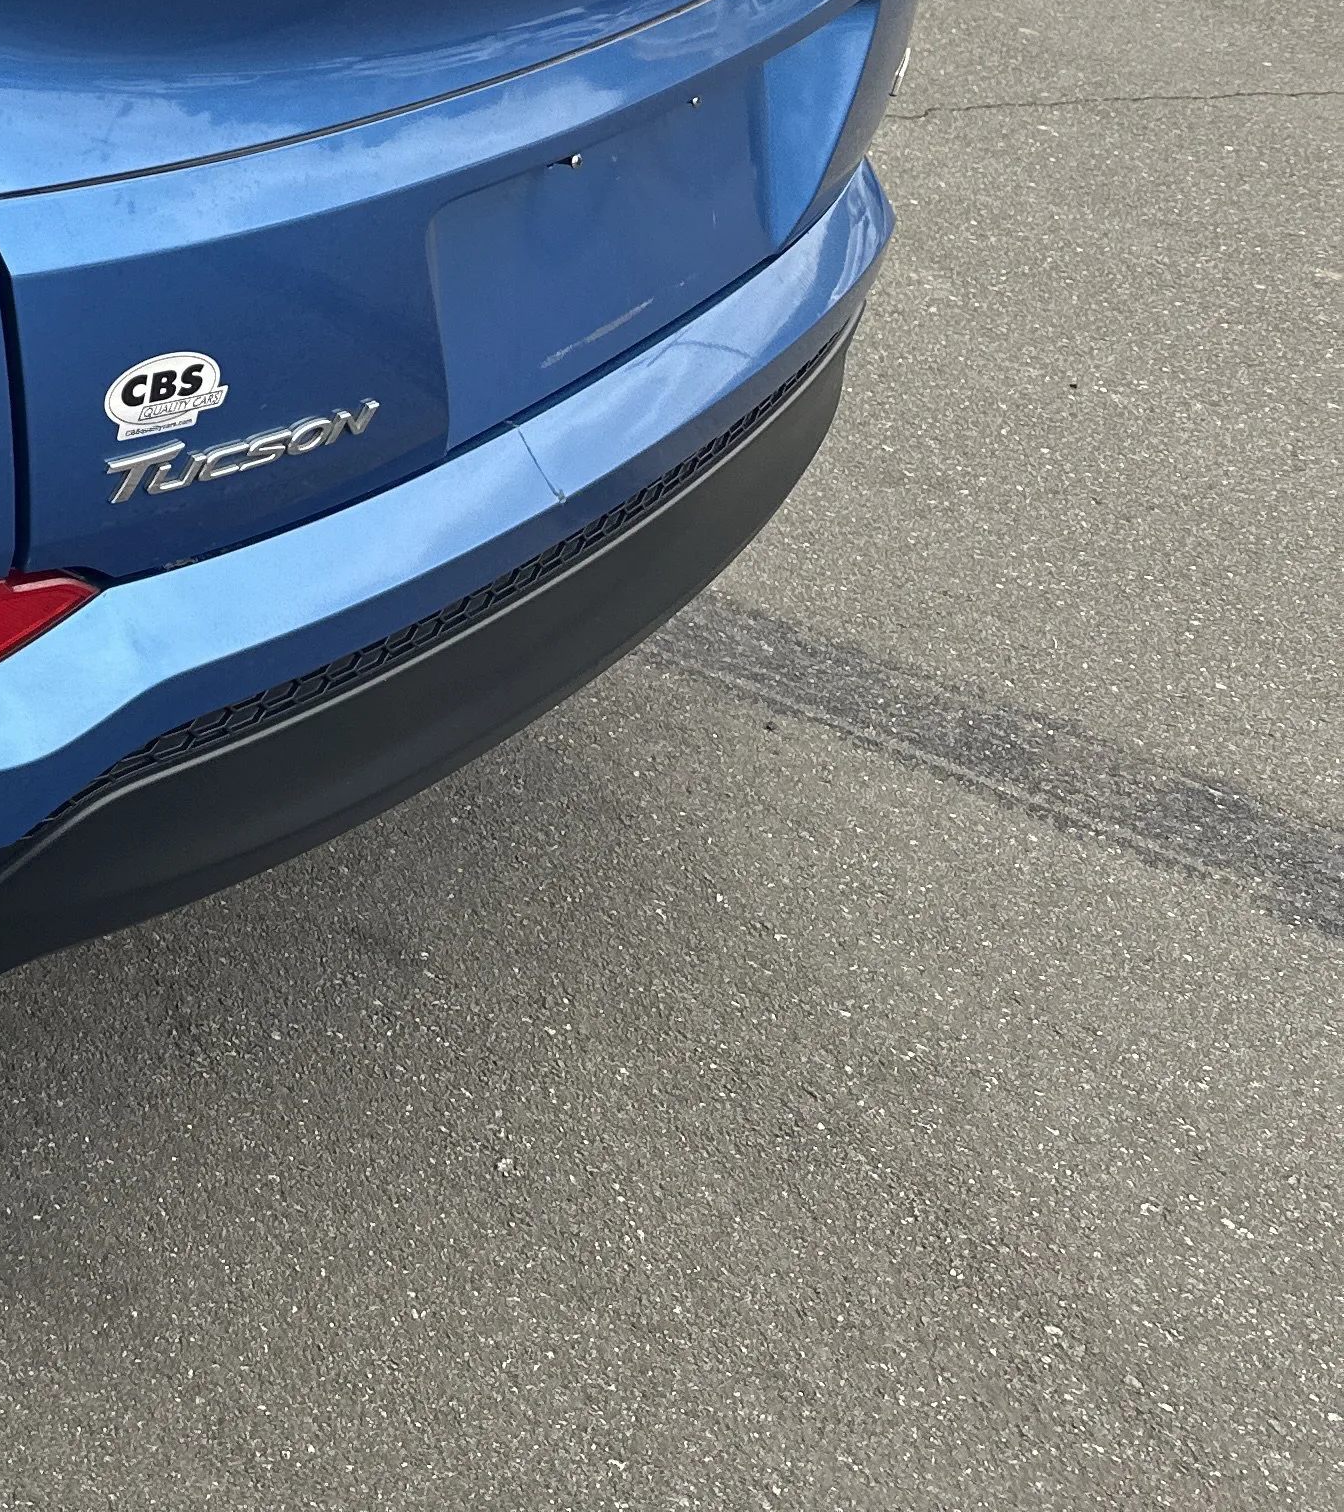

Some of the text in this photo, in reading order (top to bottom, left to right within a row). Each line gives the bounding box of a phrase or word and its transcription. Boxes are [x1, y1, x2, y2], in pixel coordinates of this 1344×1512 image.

[121, 363, 204, 407] CBS
[143, 392, 219, 419] QUALITY CARS
[104, 397, 380, 504] TUCSON
